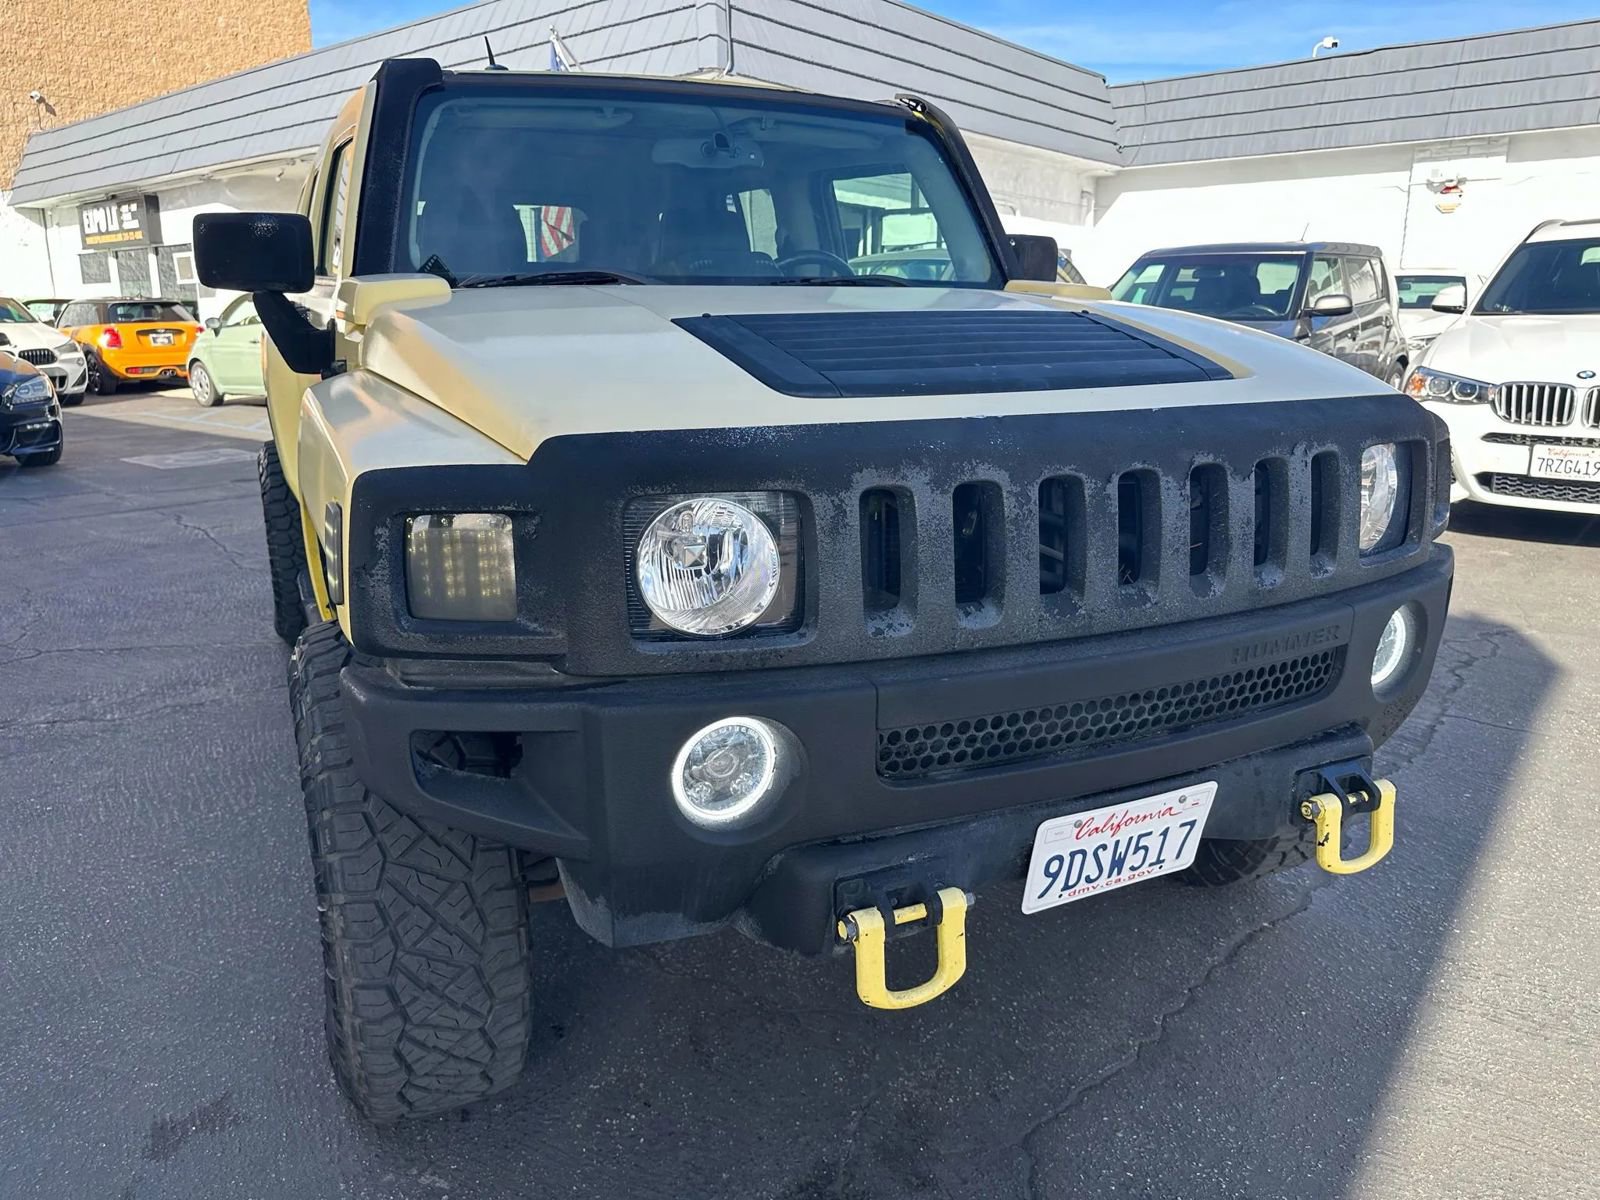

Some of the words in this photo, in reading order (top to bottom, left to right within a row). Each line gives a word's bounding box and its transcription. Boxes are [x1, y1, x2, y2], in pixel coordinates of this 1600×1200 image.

[1538, 457, 1600, 476] 7RZG419
[1231, 624, 1340, 664] HUMMER
[1075, 802, 1183, 840] California
[1037, 819, 1198, 899] 9DSW517
[1067, 867, 1155, 898] dmv.ca.gov
